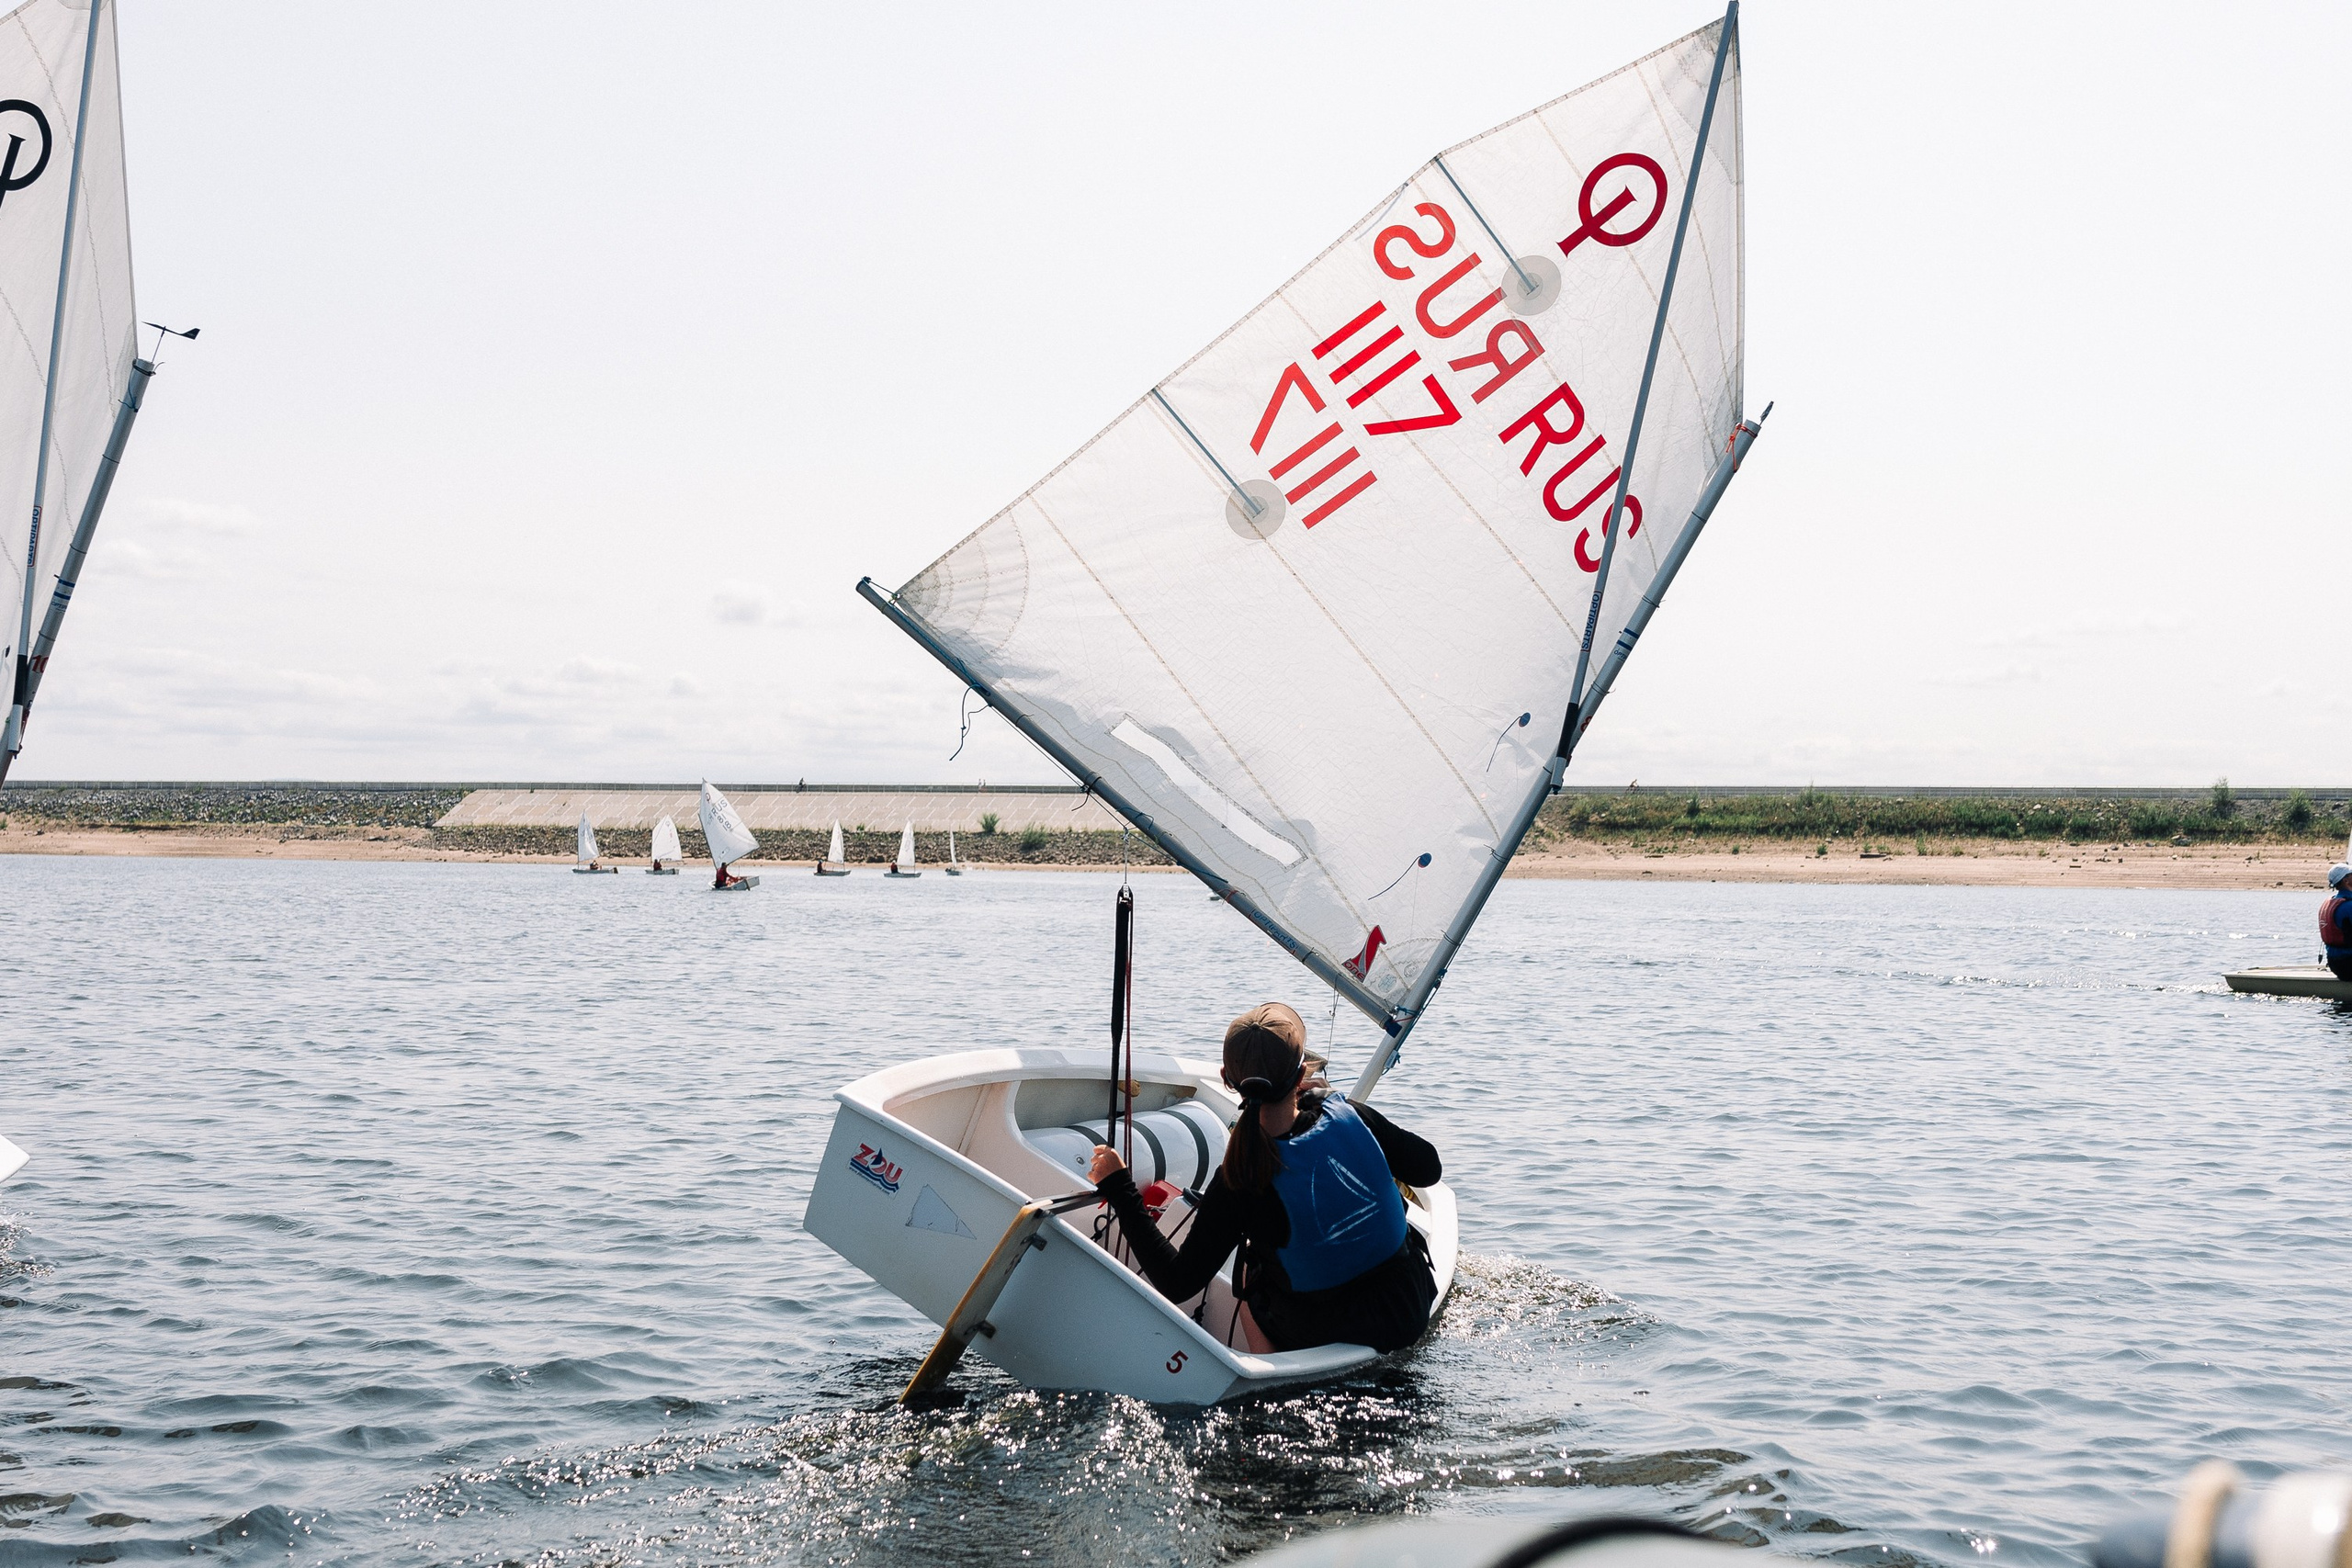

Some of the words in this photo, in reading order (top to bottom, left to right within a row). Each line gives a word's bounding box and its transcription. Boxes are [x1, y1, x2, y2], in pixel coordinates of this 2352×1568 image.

[1311, 300, 1463, 436] 1117
[1498, 381, 1643, 573] RUS
[27, 508, 40, 565] OPTIPARTS
[1581, 593, 1600, 649] OPTIPARTS
[711, 799, 728, 817] RUS
[853, 1143, 903, 1183] ZOU
[1166, 1349, 1189, 1374] 5
